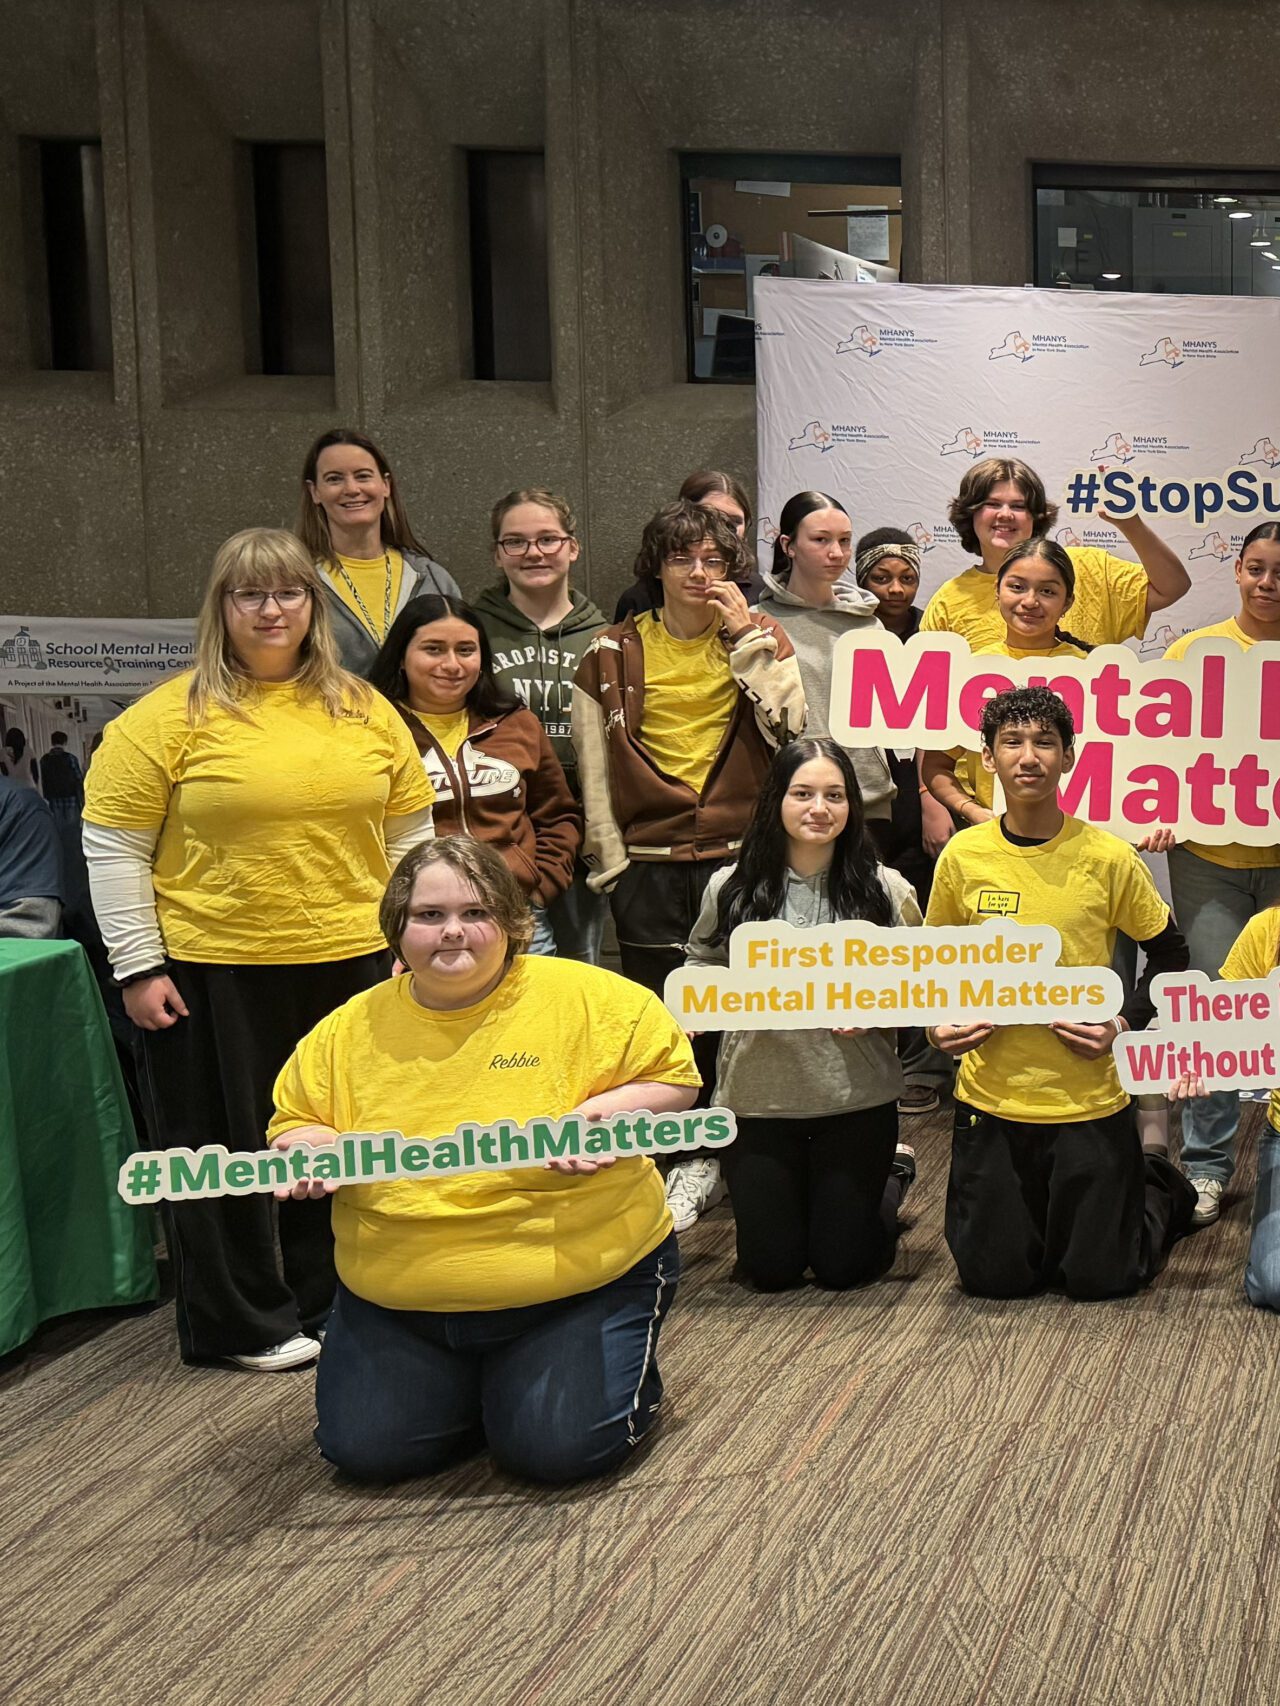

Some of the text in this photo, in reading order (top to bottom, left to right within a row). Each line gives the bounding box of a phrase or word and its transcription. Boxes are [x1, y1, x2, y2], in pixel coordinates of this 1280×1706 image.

[879, 329, 915, 337] MHANYS
[1032, 334, 1067, 343] MHANYS
[1182, 340, 1218, 348] MHANYS
[831, 424, 867, 433] MHANYS
[983, 430, 1019, 439] MHANYS
[1132, 436, 1168, 444] MHANYS
[1082, 530, 1118, 538] MHANYS
[46, 642, 195, 655] School Mental Heal
[47, 658, 194, 670] Resource Training Cen
[512, 678, 573, 712] NYC
[849, 648, 1226, 739] Mental
[545, 724, 572, 734] 1987
[748, 935, 1043, 973] First Responder
[683, 979, 1105, 1014] Mental Health Matters
[1163, 984, 1270, 1022] There
[488, 1051, 541, 1070] Rebbie
[1126, 1041, 1276, 1083] Without
[127, 1113, 730, 1197] #MentalHealthMatters
